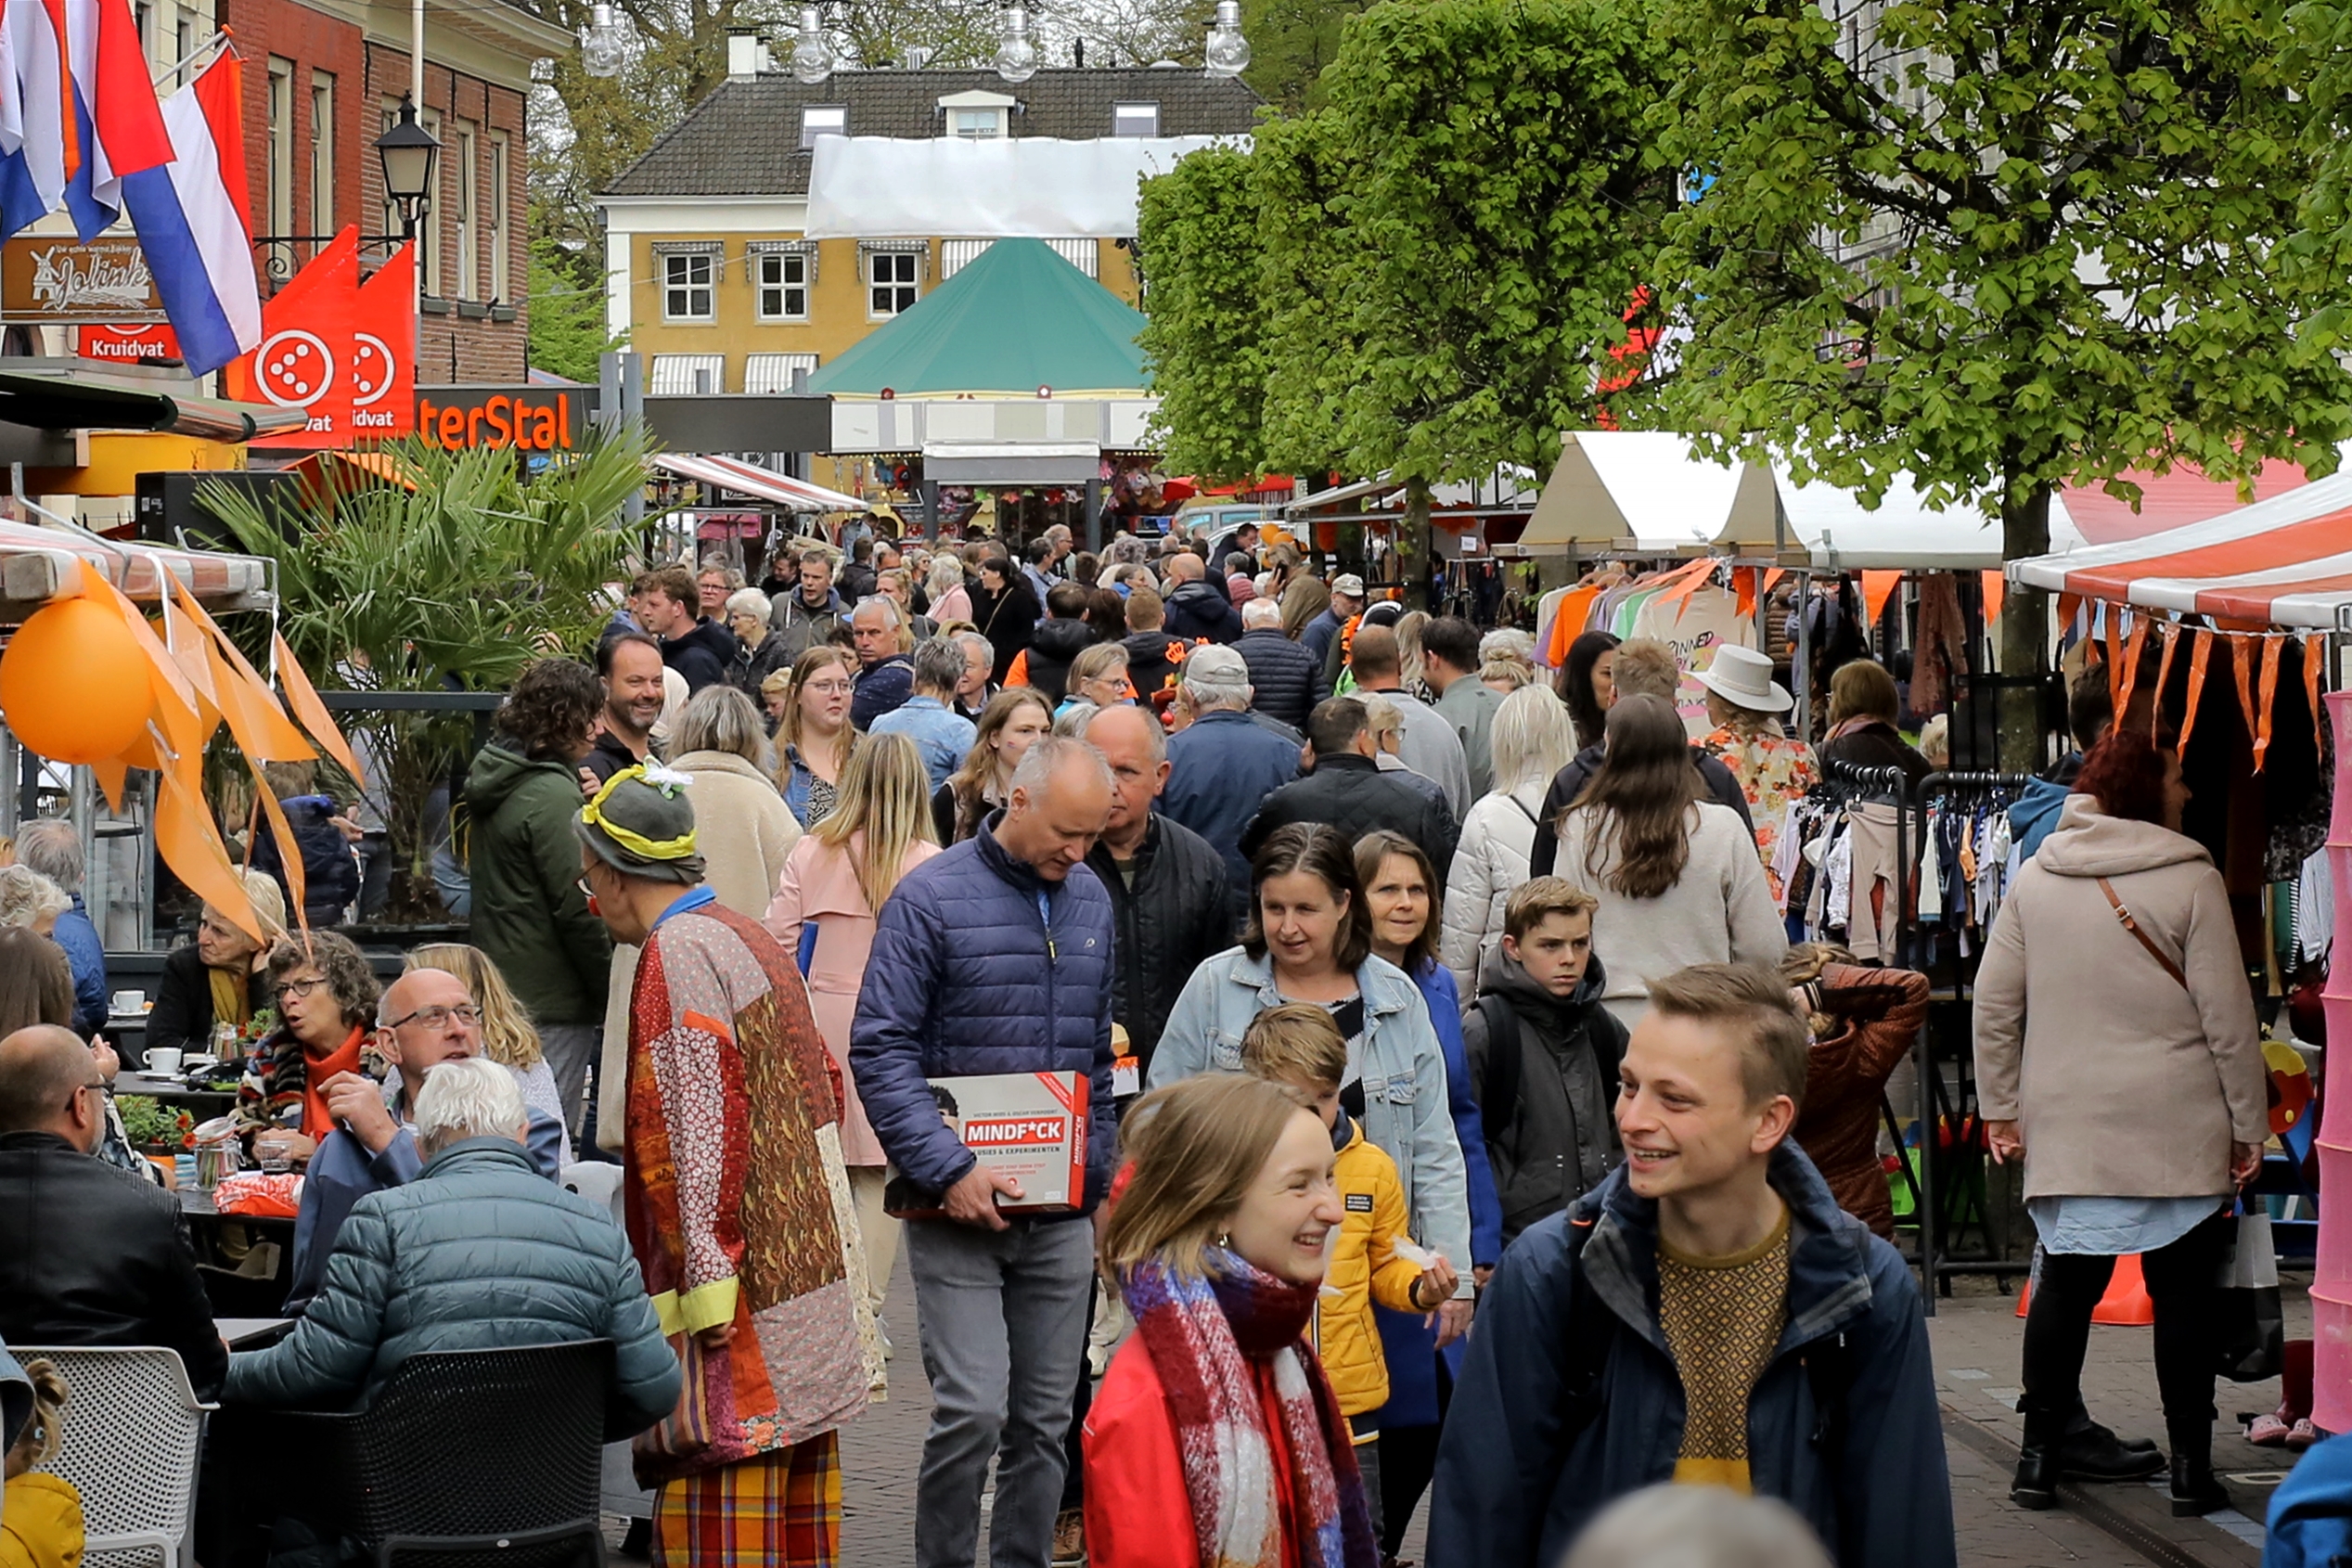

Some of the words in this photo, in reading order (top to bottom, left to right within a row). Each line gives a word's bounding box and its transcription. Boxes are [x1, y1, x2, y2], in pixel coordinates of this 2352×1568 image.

[55, 246, 151, 311] Jolink
[92, 340, 165, 357] Kruidvat
[419, 392, 572, 451] terStal
[1006, 1146, 1060, 1154] EXPERIMENTEN
